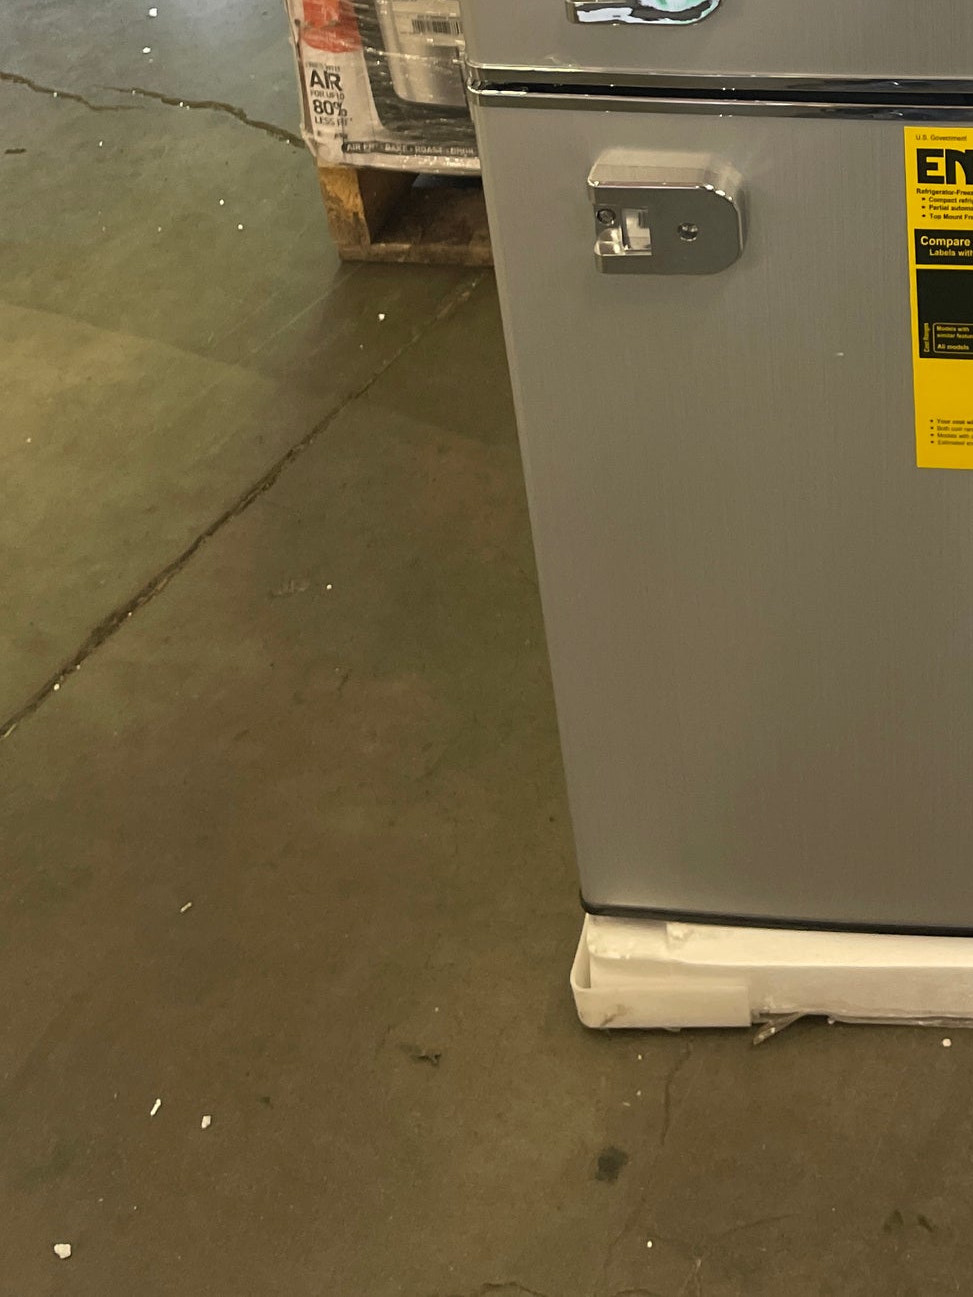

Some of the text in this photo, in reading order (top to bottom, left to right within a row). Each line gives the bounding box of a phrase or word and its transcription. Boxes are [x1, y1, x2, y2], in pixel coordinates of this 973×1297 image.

[309, 68, 343, 92] AIR
[312, 99, 348, 118] 80%
[928, 196, 957, 205] Compact
[928, 204, 949, 212] Partial
[930, 212, 942, 221] Top
[943, 213, 963, 221] Mount
[920, 235, 971, 248] Compare
[929, 248, 956, 257] Labels
